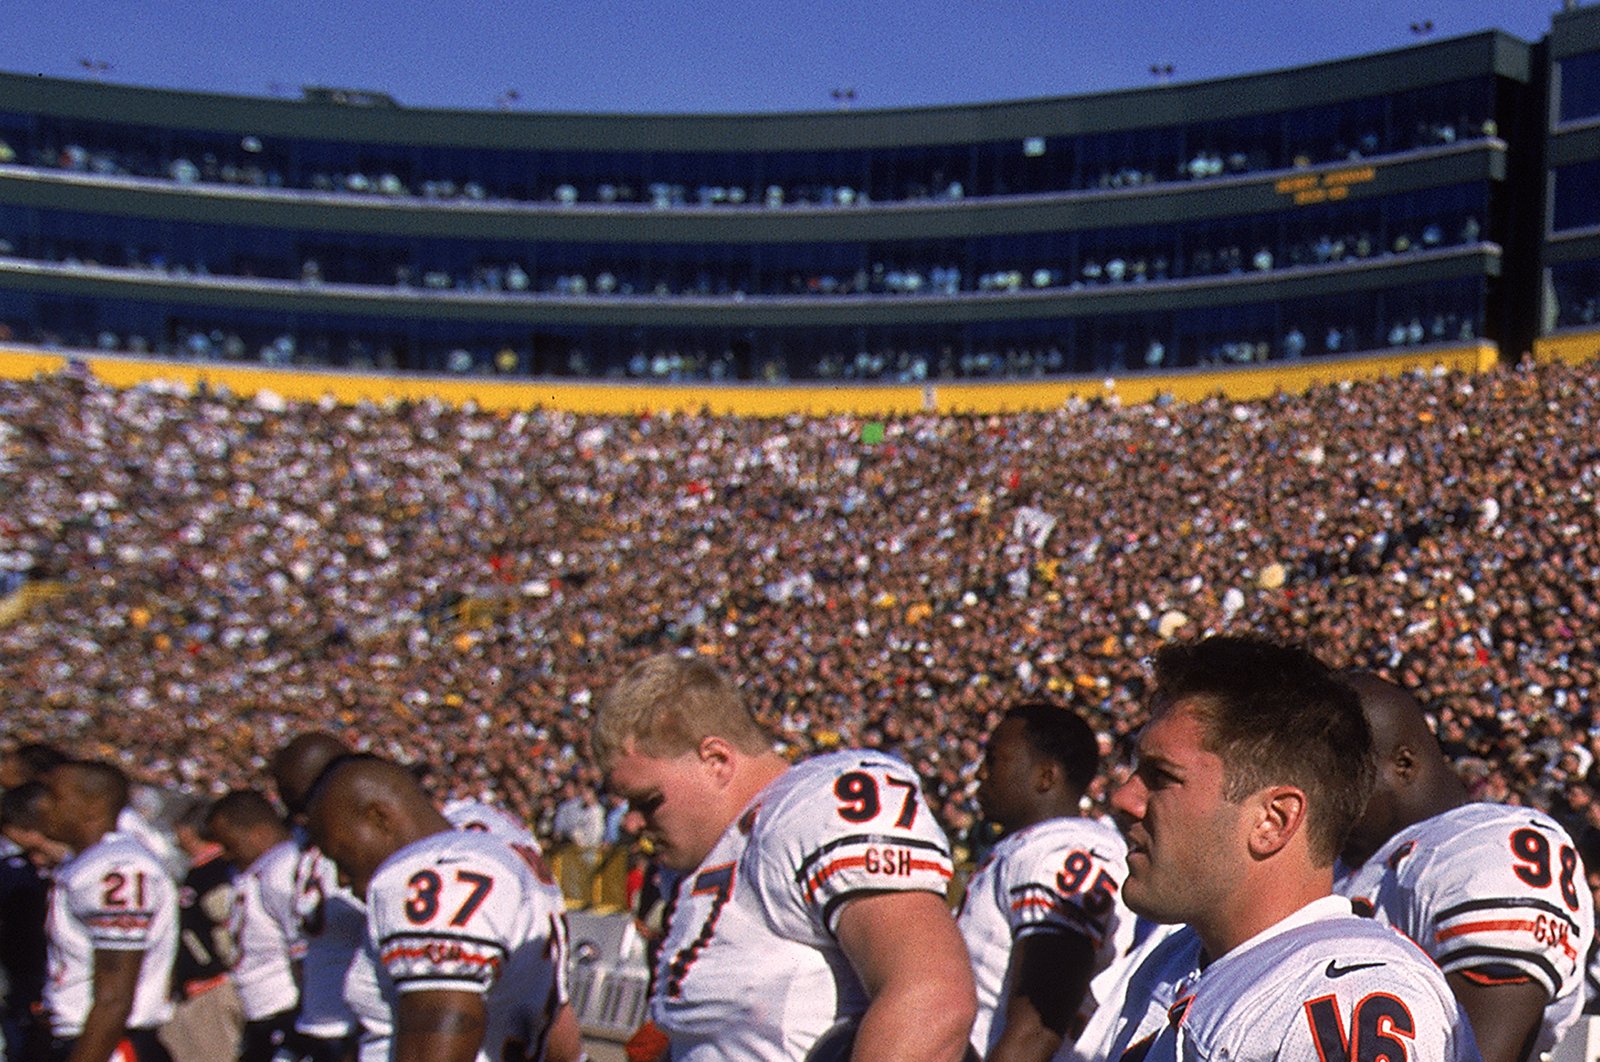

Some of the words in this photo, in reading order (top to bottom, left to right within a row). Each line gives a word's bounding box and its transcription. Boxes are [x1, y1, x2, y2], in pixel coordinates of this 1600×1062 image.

[833, 771, 918, 831] 97
[102, 869, 147, 910] 21
[864, 847, 912, 877] GSH
[1056, 848, 1119, 916] 95
[1509, 828, 1580, 912] 98
[404, 867, 494, 927] 37
[652, 861, 737, 1001] 7
